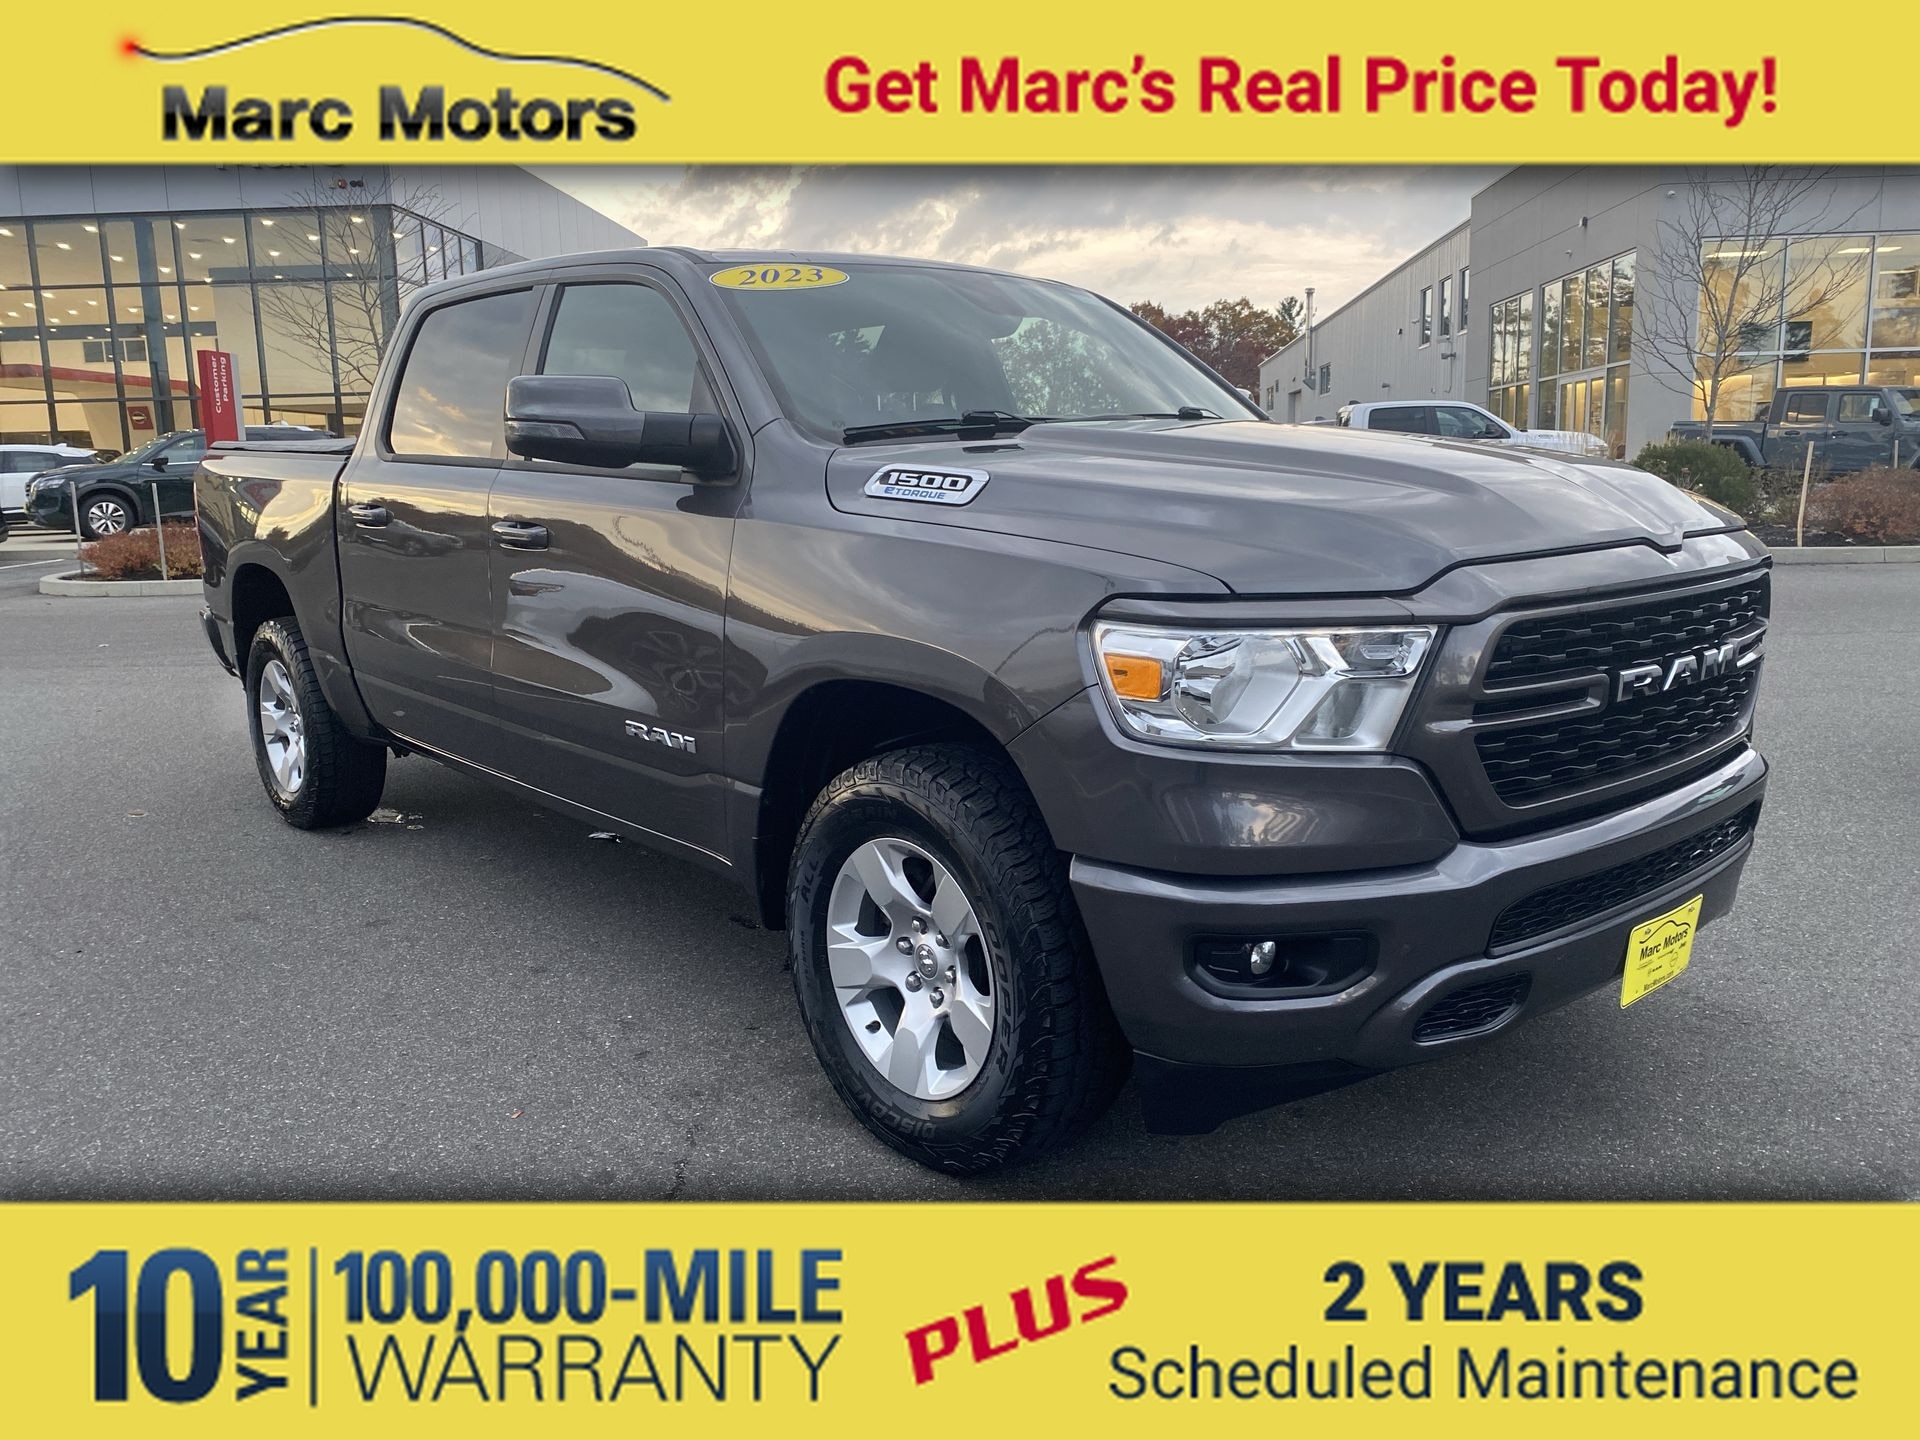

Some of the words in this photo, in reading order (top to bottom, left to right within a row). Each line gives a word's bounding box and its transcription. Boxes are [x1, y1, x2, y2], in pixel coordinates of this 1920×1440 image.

[738, 268, 824, 286] 2023
[211, 355, 222, 414] Customer
[220, 356, 229, 402] Parking
[887, 471, 967, 490] 1500
[1617, 644, 1733, 702] RAM
[625, 720, 697, 754] RAM
[1639, 943, 1661, 961] Marc
[1662, 928, 1688, 950] Motors
